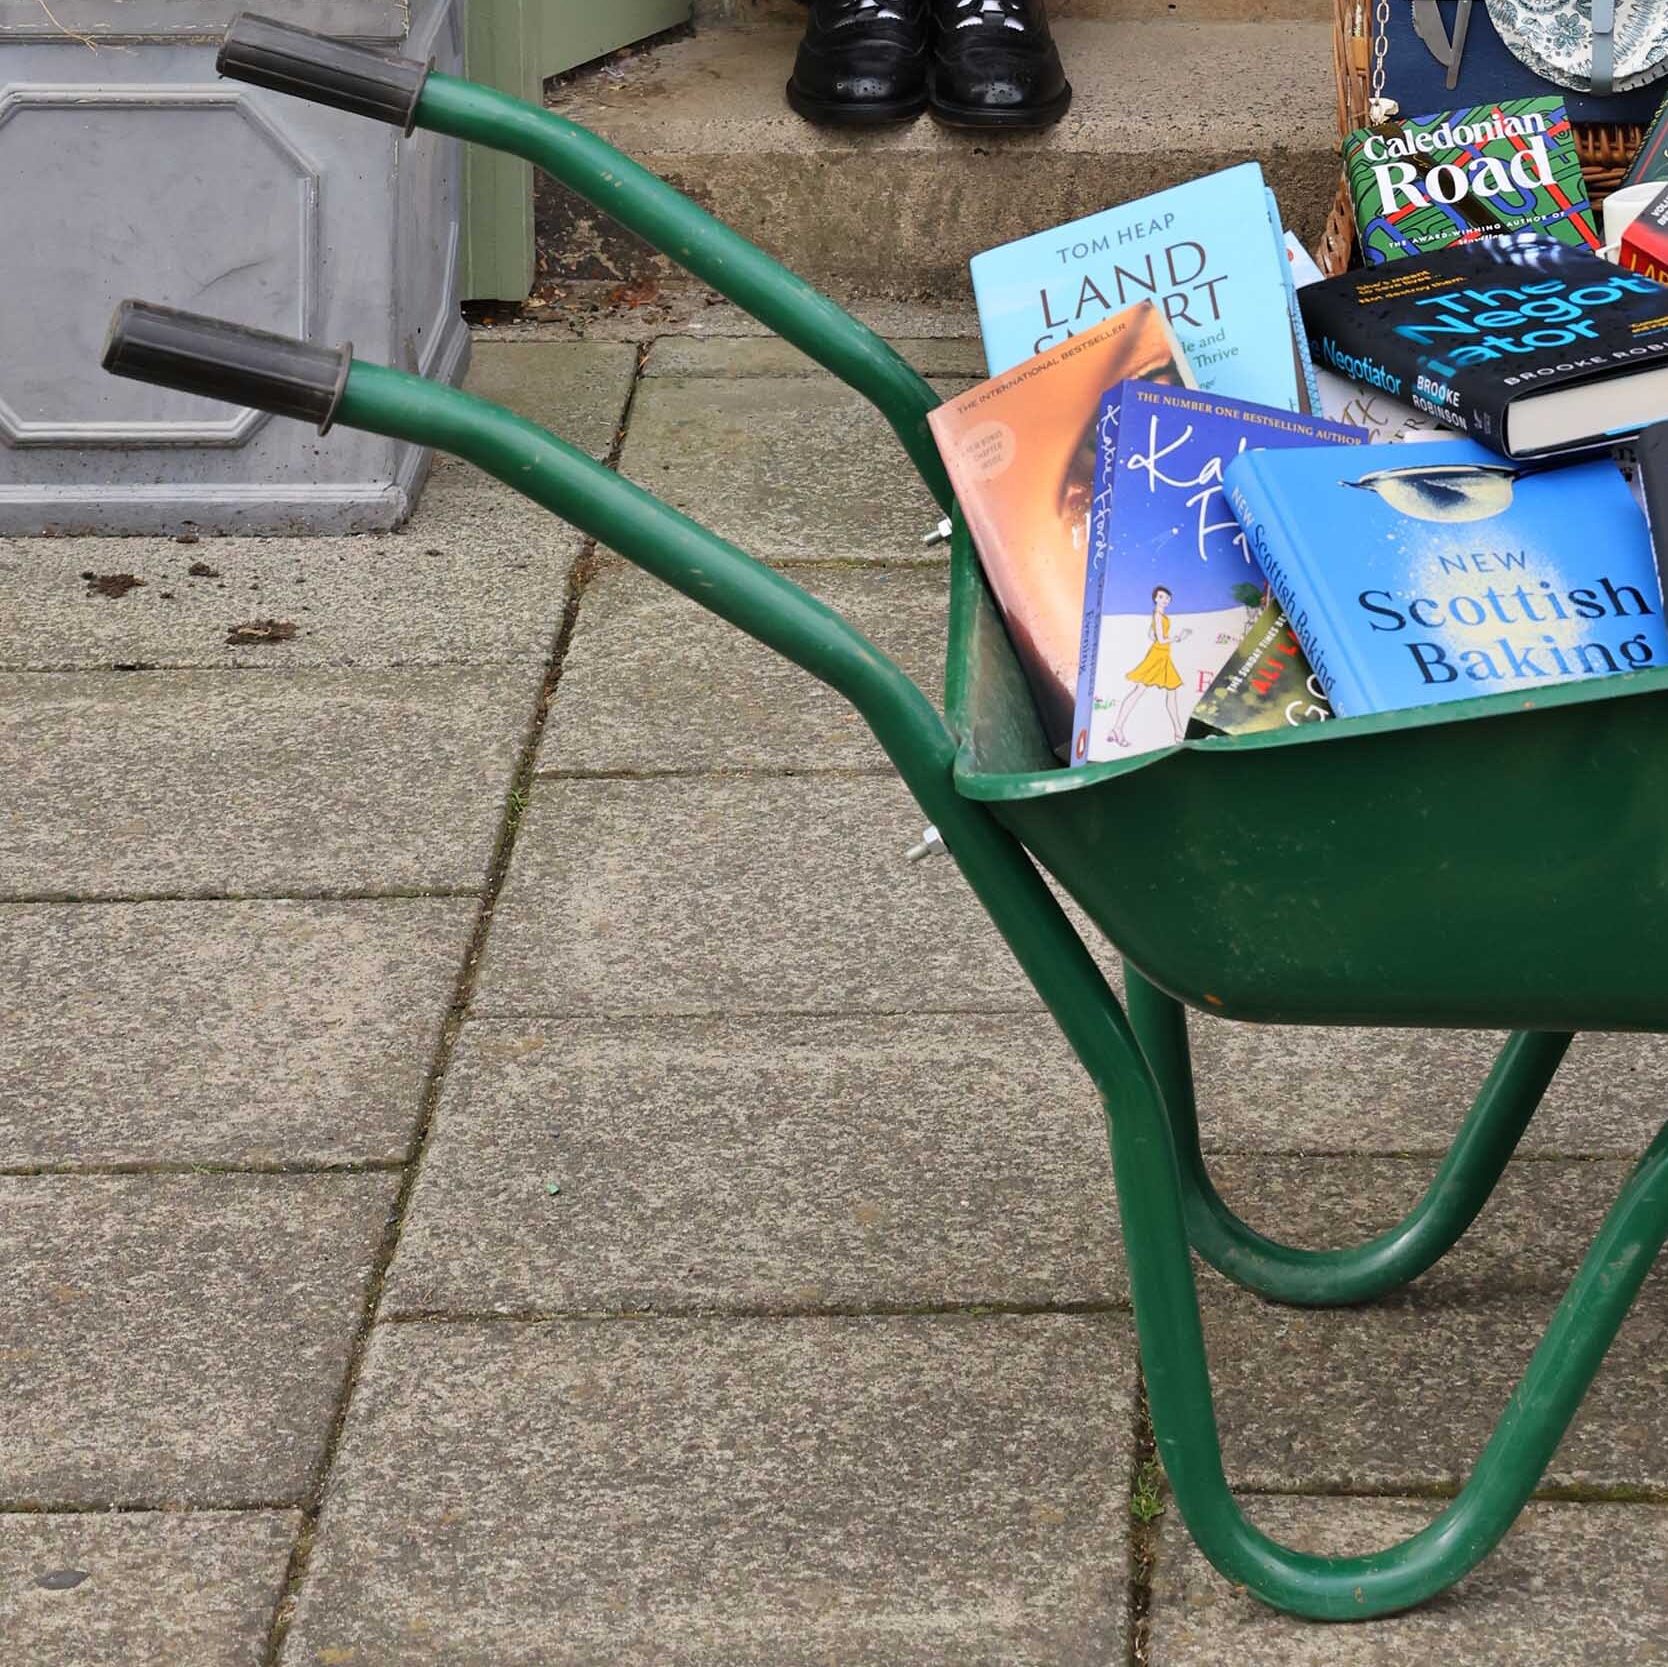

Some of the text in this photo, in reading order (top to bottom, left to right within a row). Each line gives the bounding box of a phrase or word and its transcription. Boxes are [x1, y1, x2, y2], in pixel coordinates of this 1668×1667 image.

[1363, 113, 1547, 161] Caledonian
[1371, 135, 1557, 215] Road
[1056, 213, 1176, 264] TOM HEAP
[1412, 223, 1501, 244] AWARD-WINNING
[1506, 214, 1551, 227] AUTHOR
[1040, 241, 1207, 329] LAND
[1415, 279, 1566, 313] The
[1194, 345, 1239, 369] Thrive
[1198, 328, 1226, 351] and
[1416, 319, 1600, 379] iator
[957, 322, 1127, 415] THE INTERNATIONAL BESTSELLER
[1322, 336, 1401, 396] Negotiator
[1416, 375, 1461, 408] BROOKE
[1503, 355, 1608, 386] BROOKE
[1136, 391, 1362, 445] THE NUMBER ONE BESTSELLING AUTHOR
[1412, 394, 1468, 431] ROBINSON
[1439, 549, 1529, 576] NEW
[1230, 486, 1256, 527] NEW
[1252, 524, 1297, 621] Scottish
[1294, 610, 1337, 695] Baking
[1357, 576, 1656, 633] Scottish
[1227, 625, 1278, 694] THE SUNDAY TIMES
[1251, 657, 1284, 695] ALI
[1404, 633, 1656, 685] Baking
